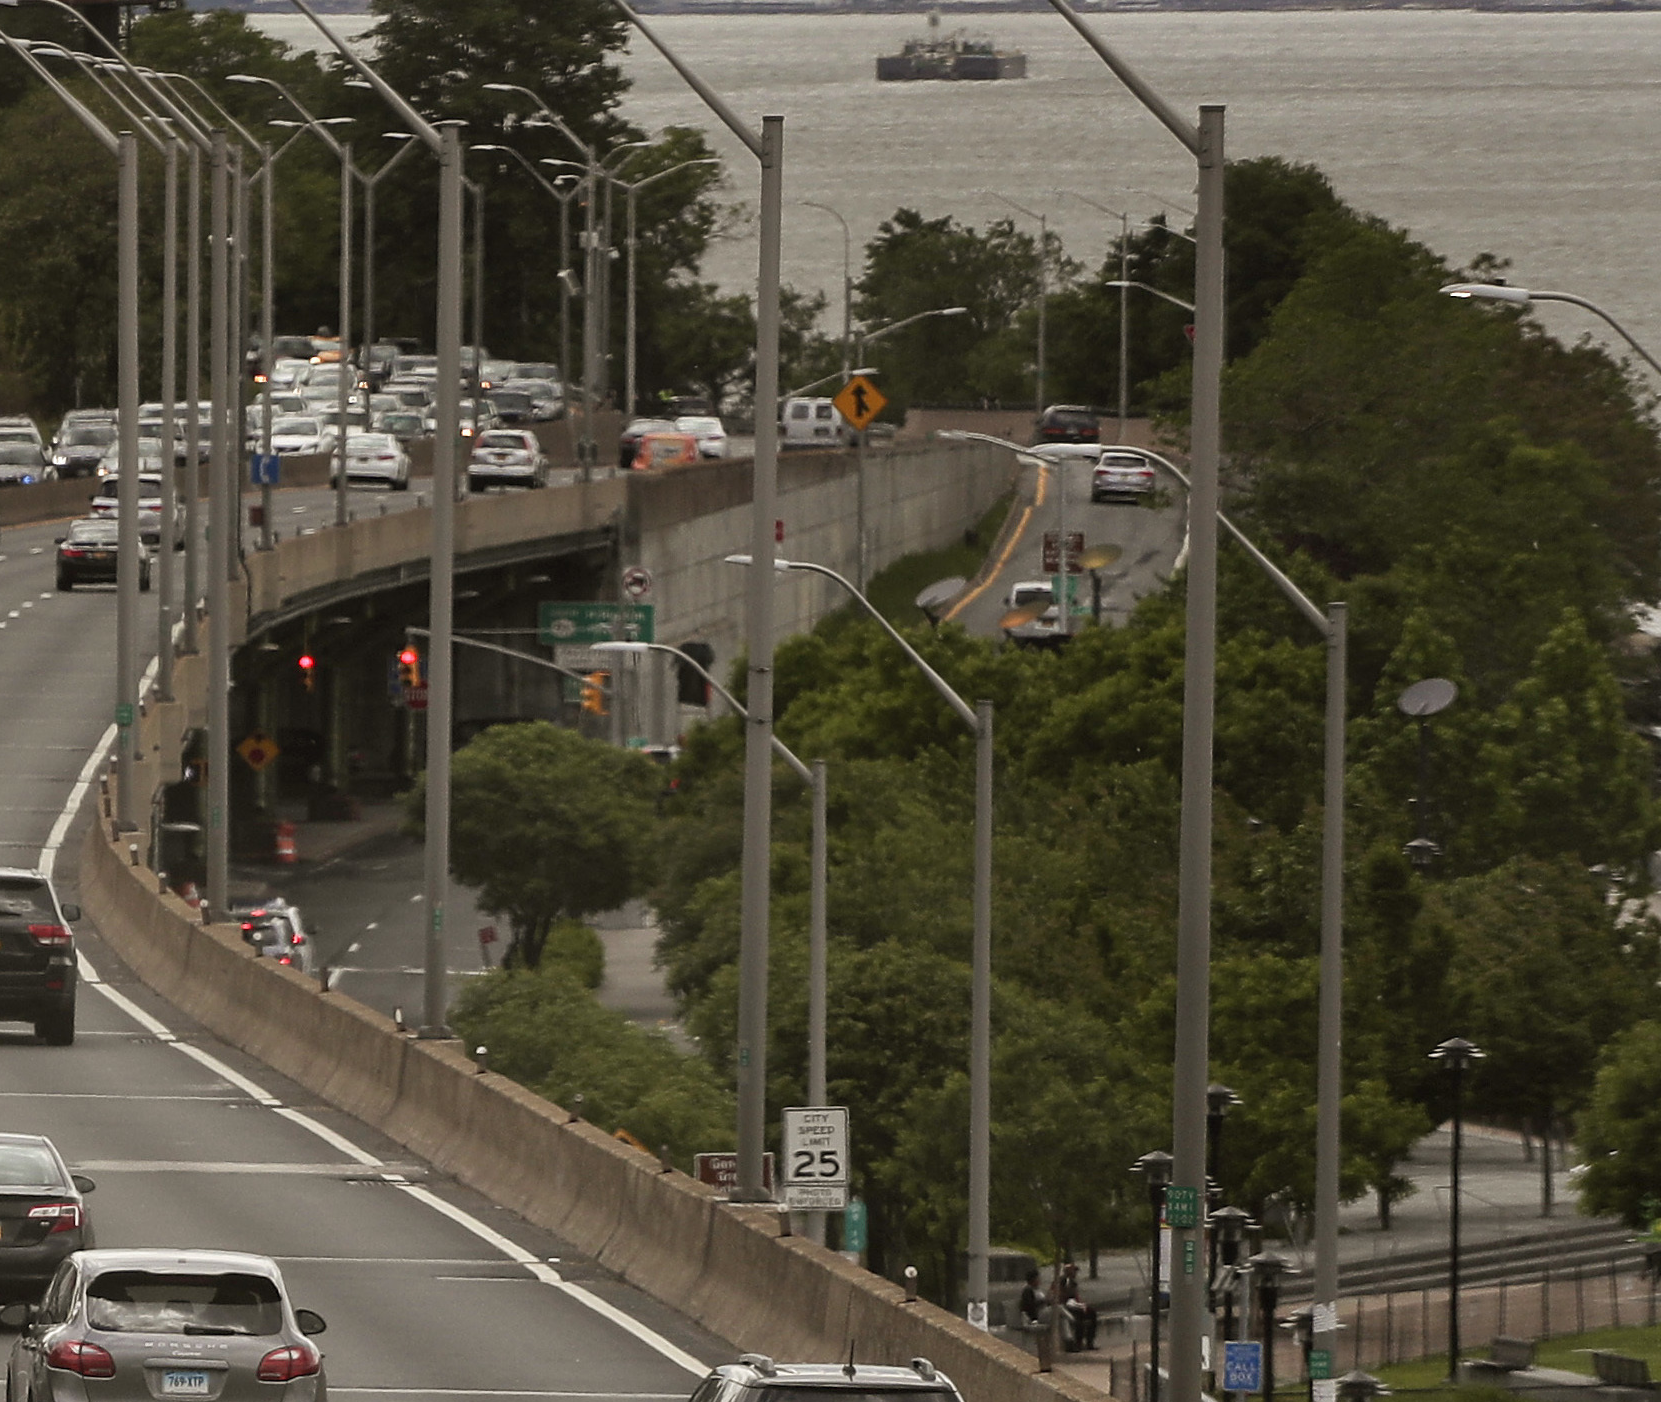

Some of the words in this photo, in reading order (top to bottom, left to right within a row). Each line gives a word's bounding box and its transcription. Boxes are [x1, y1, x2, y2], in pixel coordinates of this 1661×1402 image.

[803, 1114, 829, 1123] CITY
[798, 1125, 835, 1135] SPEED
[803, 1137, 831, 1146] LIMIT
[793, 1150, 840, 1178] 25
[1227, 1361, 1257, 1371] CALL
[1230, 1372, 1253, 1381] BOX
